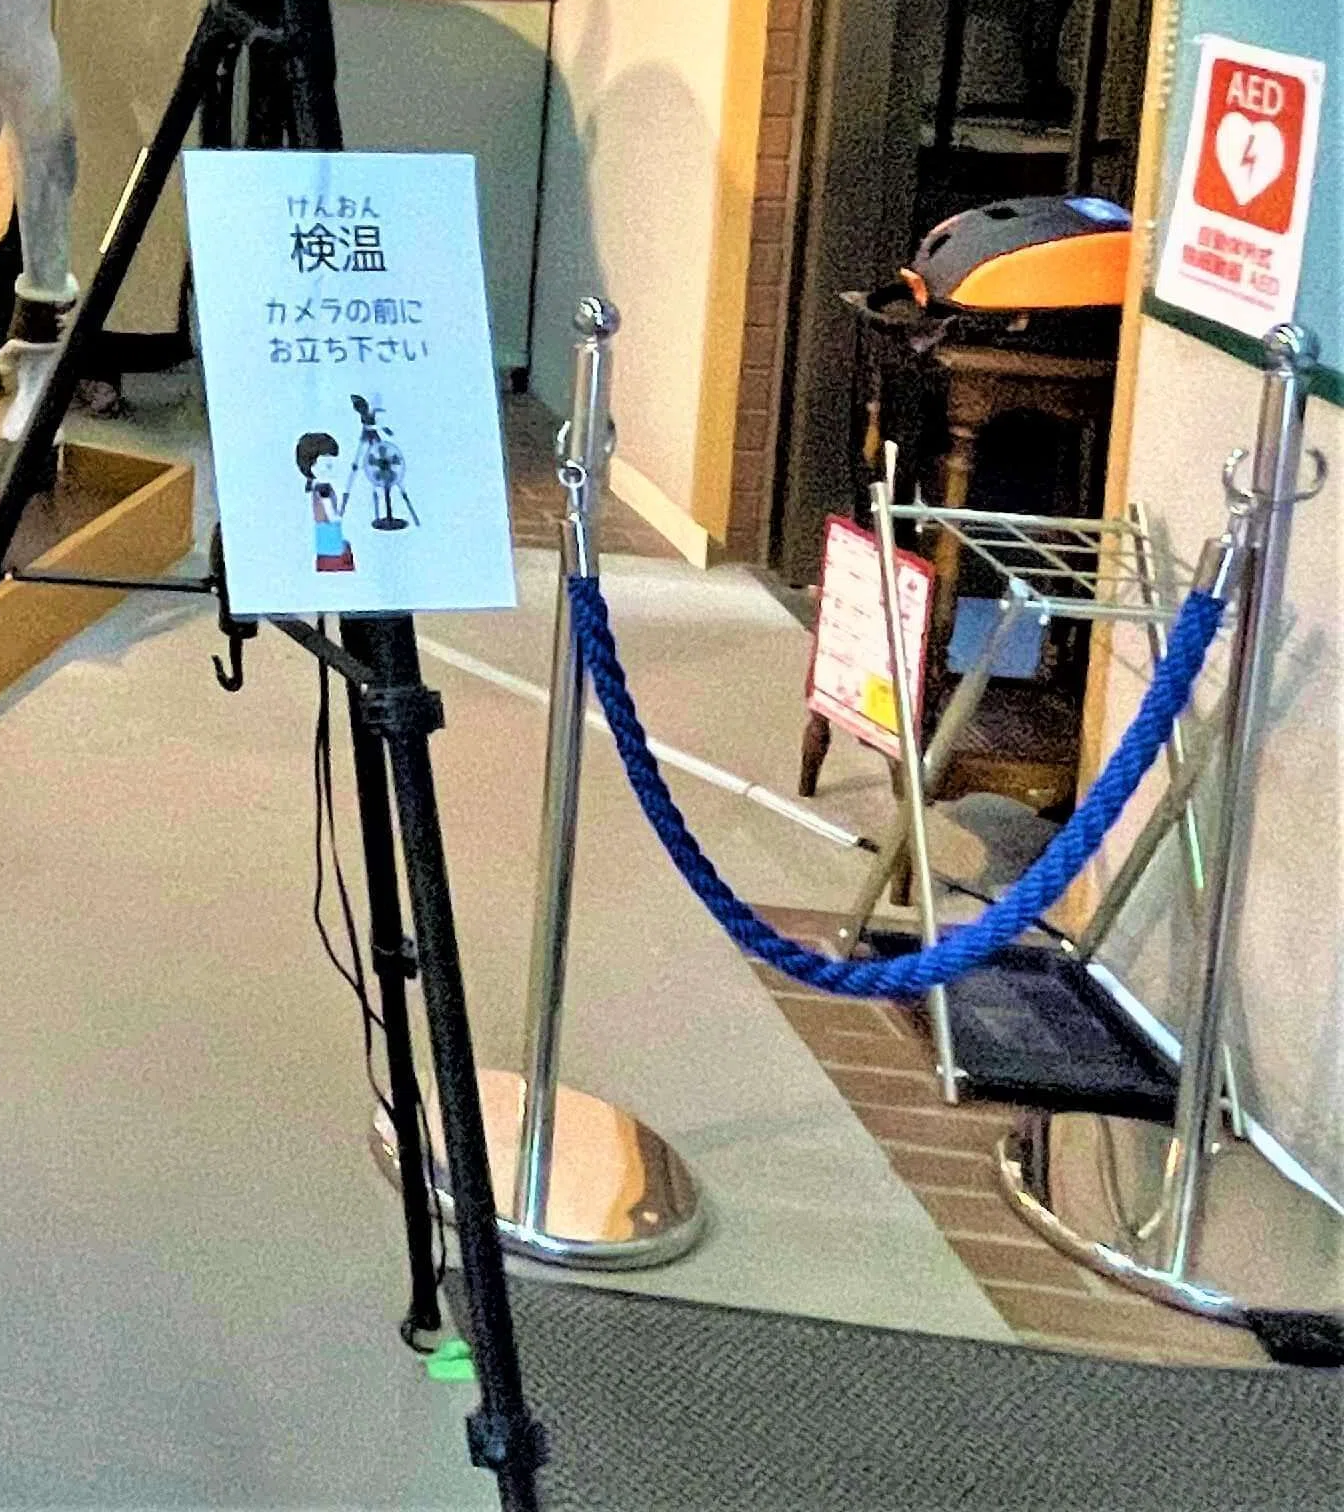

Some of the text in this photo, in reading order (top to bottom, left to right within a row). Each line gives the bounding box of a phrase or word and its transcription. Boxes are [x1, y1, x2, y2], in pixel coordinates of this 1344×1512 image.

[1225, 70, 1284, 117] AED
[287, 194, 380, 218] けんおん
[290, 223, 388, 273] 検温
[265, 297, 424, 325] カメラの前に
[268, 335, 429, 364] お立ち下さい
